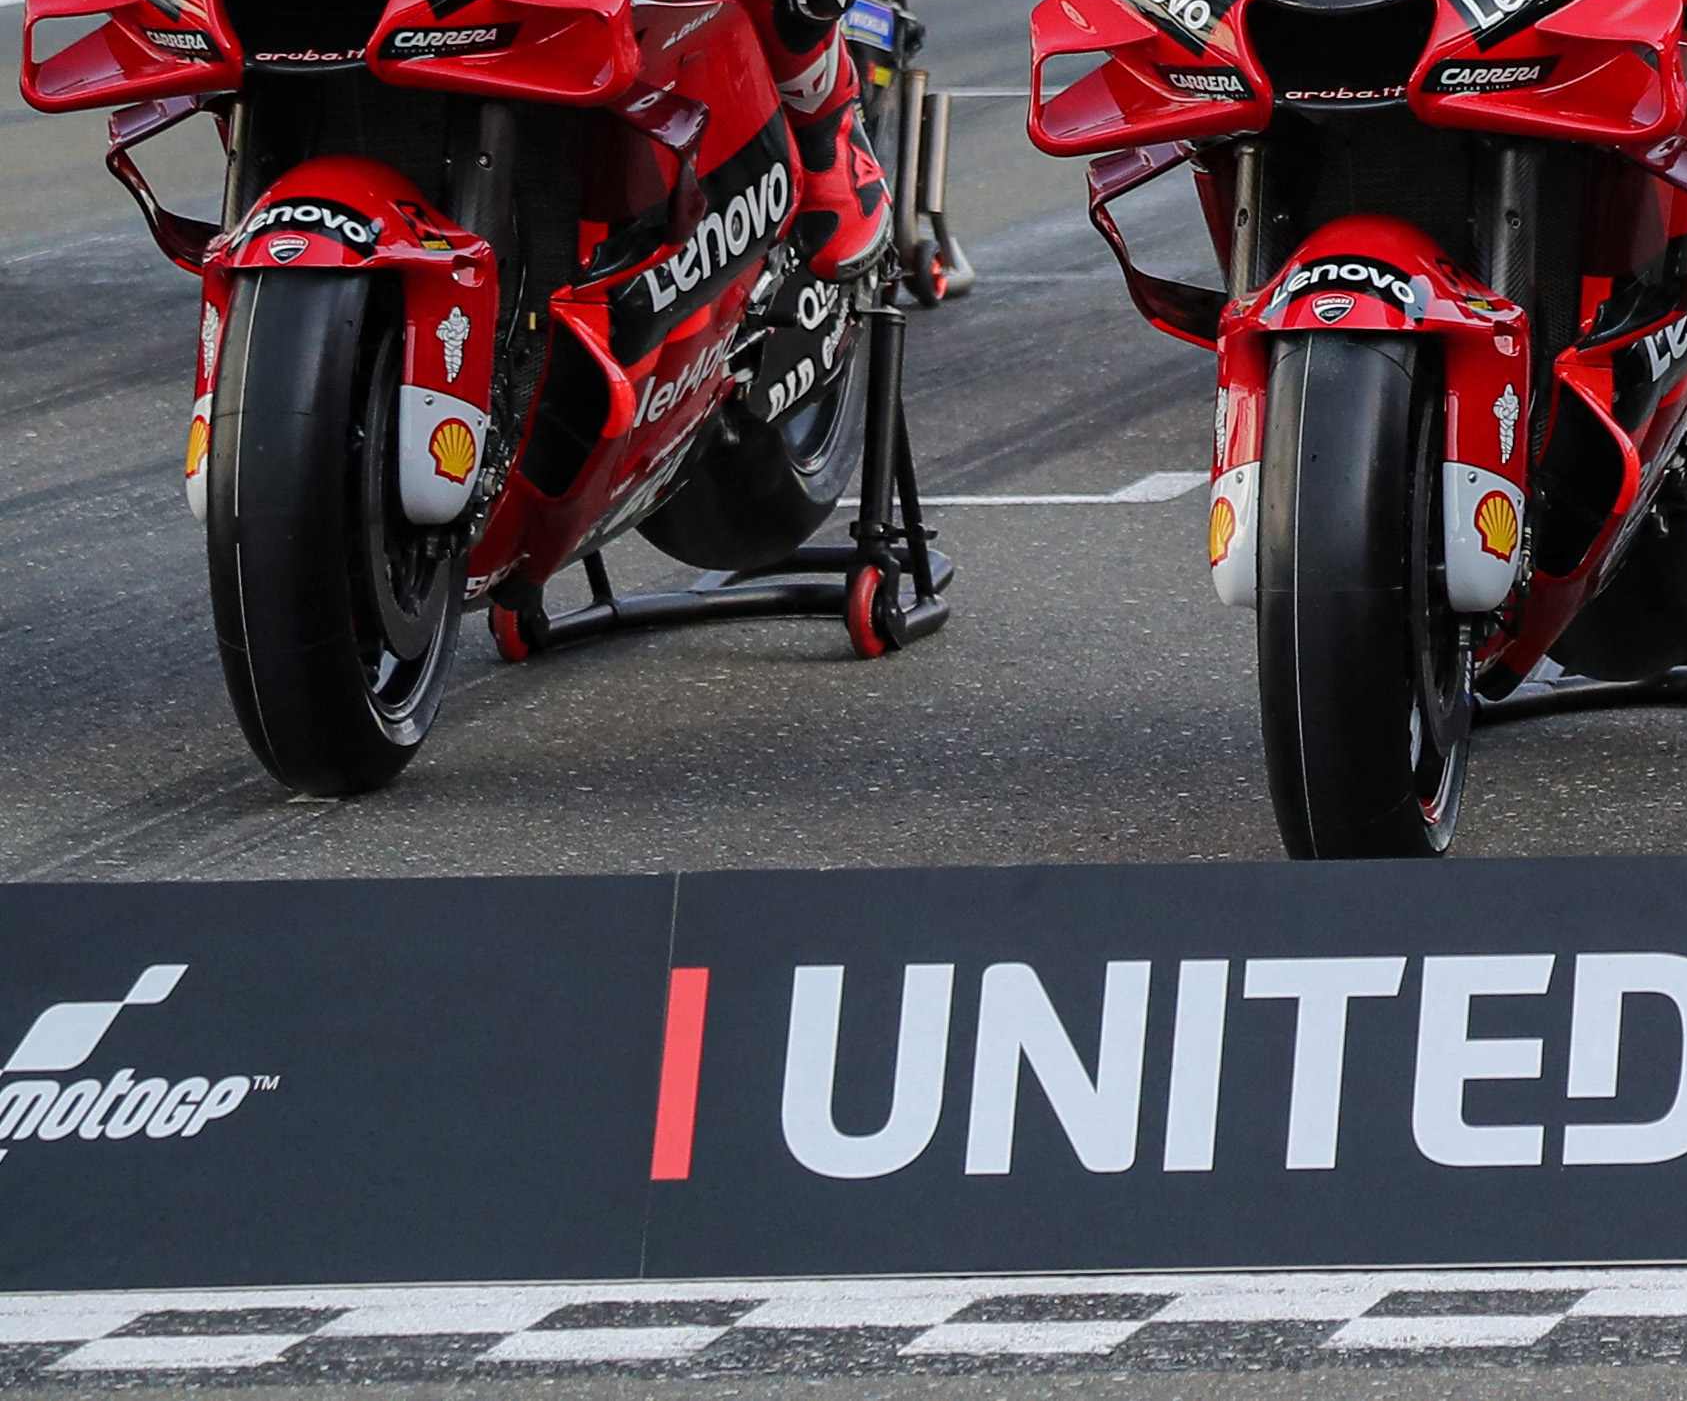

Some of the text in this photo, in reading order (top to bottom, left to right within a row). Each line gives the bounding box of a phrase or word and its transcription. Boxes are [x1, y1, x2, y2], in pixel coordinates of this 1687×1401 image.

[144, 30, 210, 52] CARRERA
[393, 27, 499, 49] CARRERA
[1168, 71, 1246, 94] CARRERA
[1438, 63, 1543, 86] CARRERA
[641, 161, 789, 313] Lenovo
[1269, 262, 1416, 309] Lenovo
